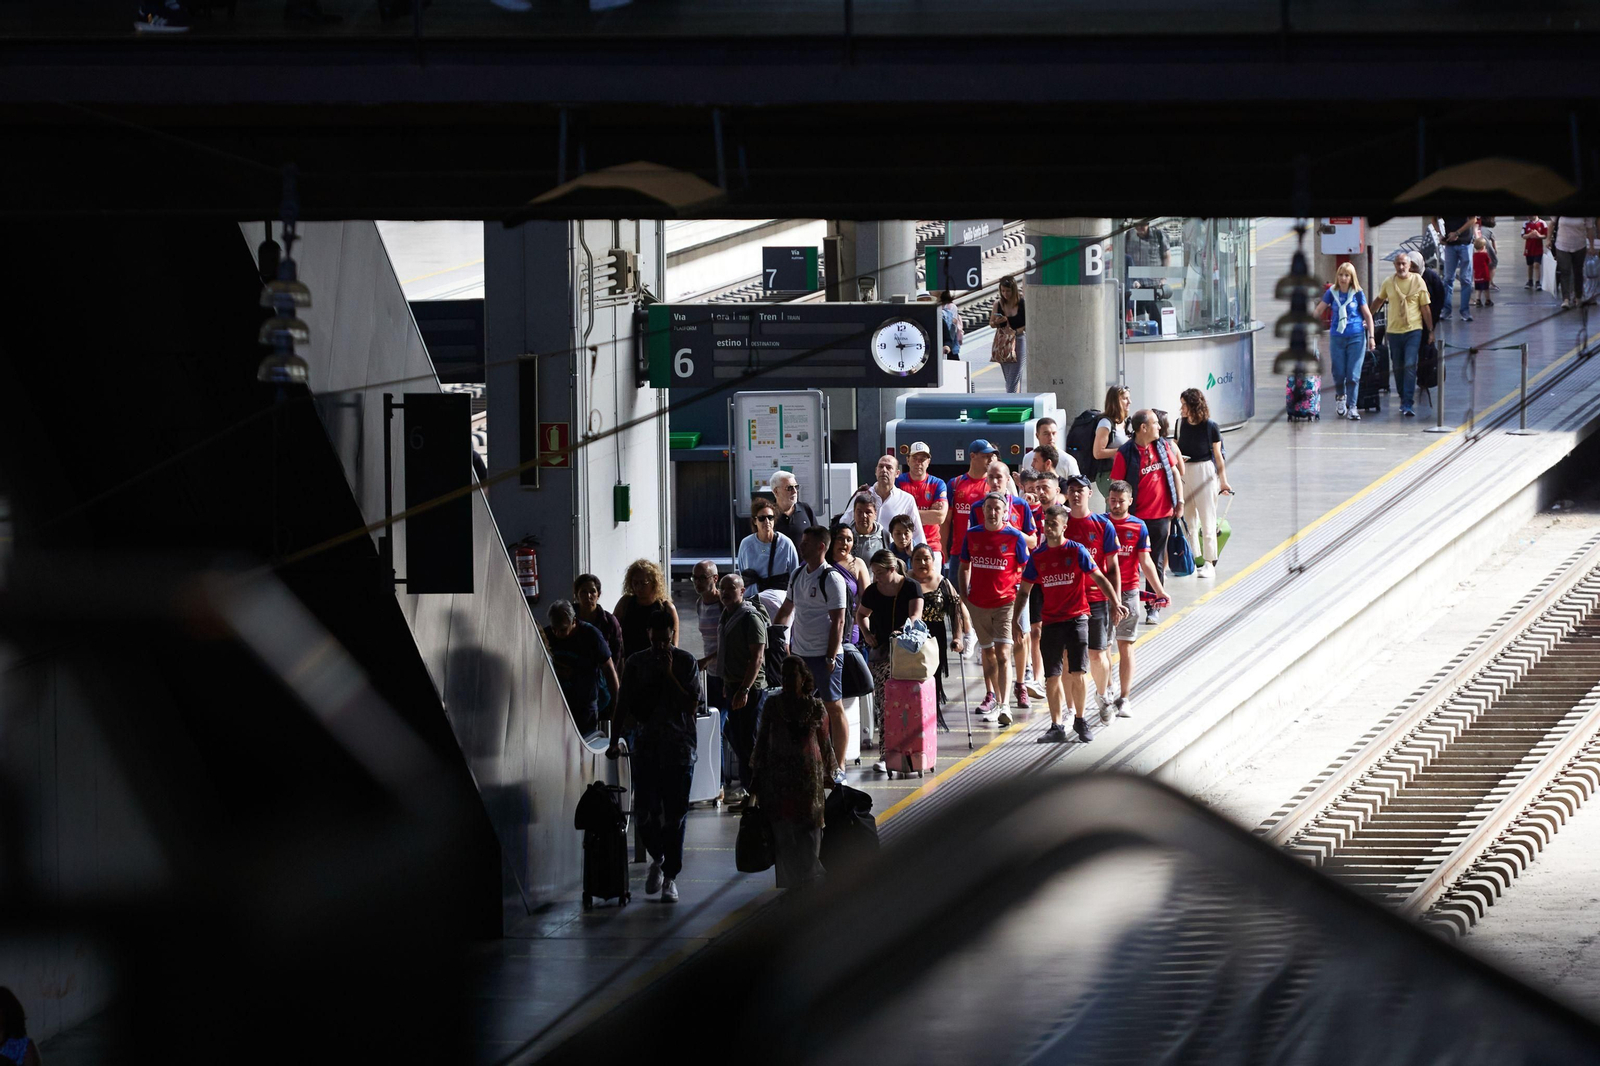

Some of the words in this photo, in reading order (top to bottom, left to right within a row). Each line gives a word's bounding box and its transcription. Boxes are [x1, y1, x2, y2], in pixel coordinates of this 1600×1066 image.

[1085, 243, 1103, 276] B
[766, 268, 777, 288] 7
[966, 267, 979, 288] 6
[759, 313, 777, 321] Tren
[716, 338, 742, 347] estino
[880, 342, 886, 350] 9
[674, 347, 695, 378] 6
[1217, 371, 1233, 385] adif
